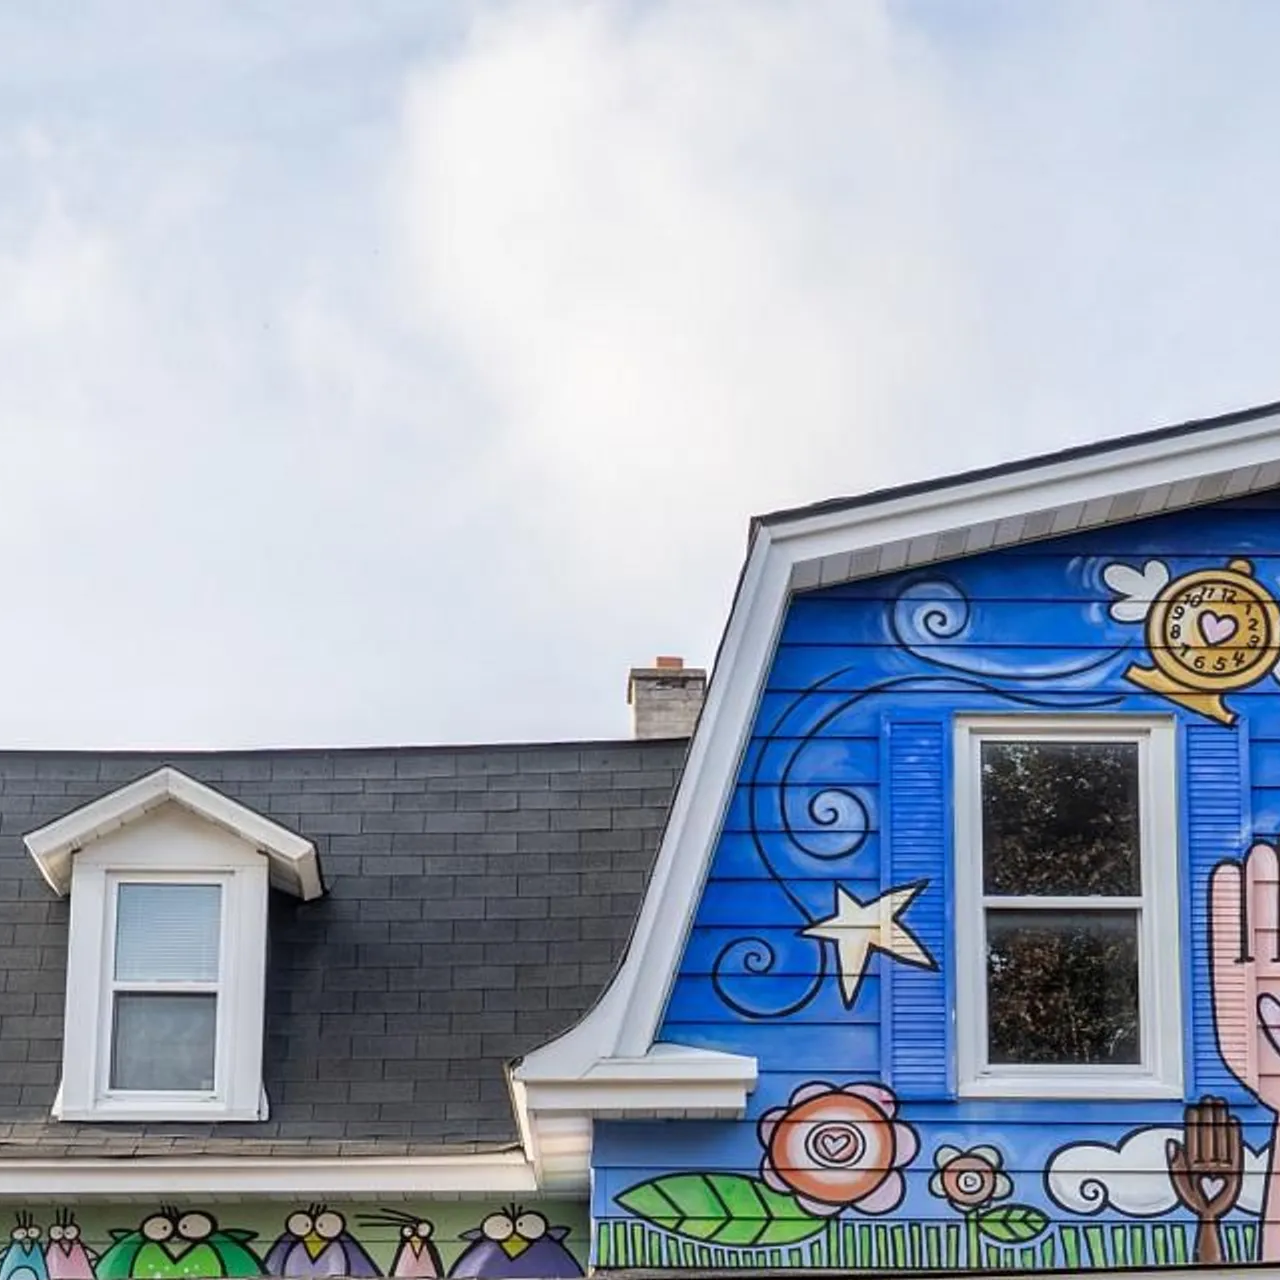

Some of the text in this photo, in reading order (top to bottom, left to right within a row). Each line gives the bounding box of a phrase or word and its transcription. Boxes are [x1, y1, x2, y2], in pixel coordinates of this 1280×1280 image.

[1184, 594, 1202, 608] 10
[1221, 588, 1237, 604] 12
[1172, 605, 1185, 620] 9
[1245, 603, 1252, 615] 1
[1170, 624, 1181, 639] 8
[1248, 618, 1258, 631] 2
[1246, 637, 1260, 649] 3
[1193, 656, 1205, 669] 6
[1212, 656, 1227, 671] 5
[1233, 650, 1245, 667] 4
